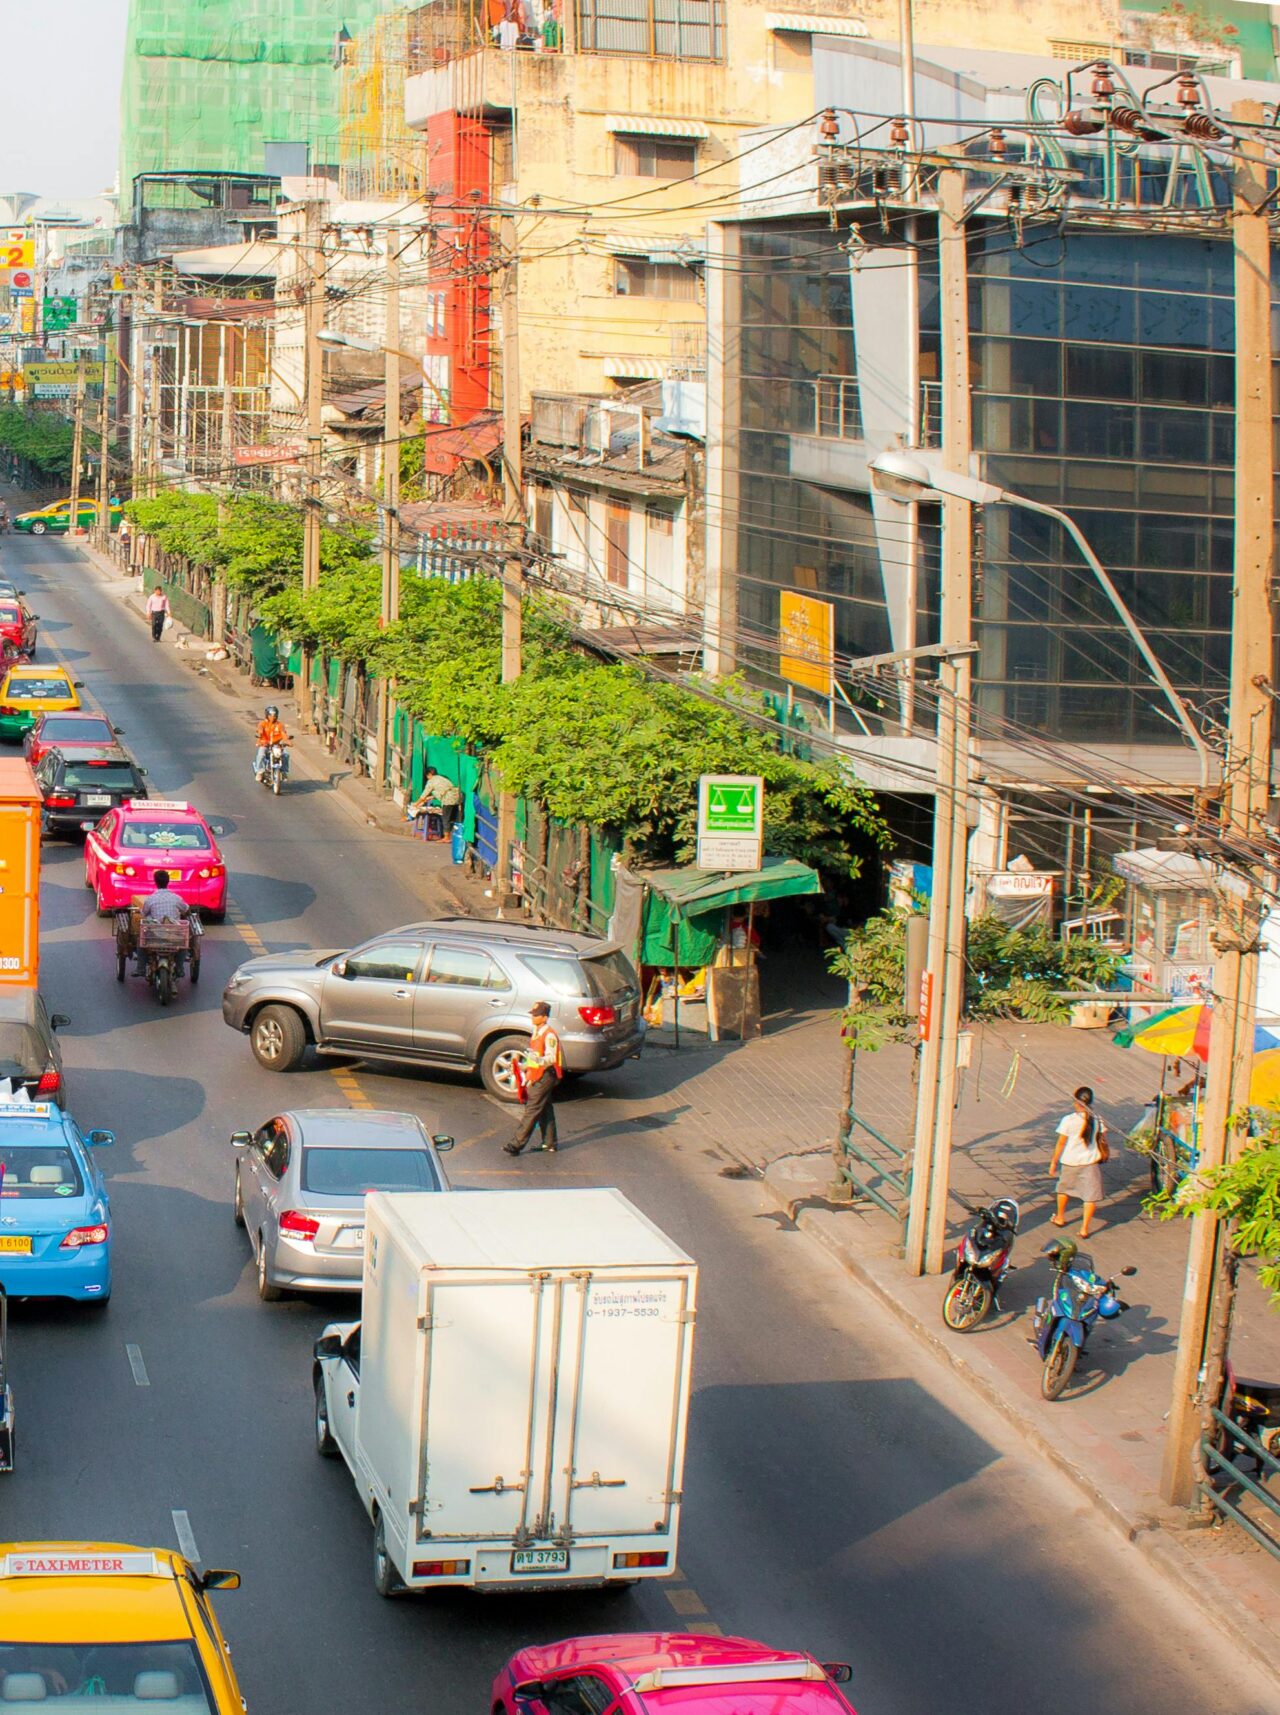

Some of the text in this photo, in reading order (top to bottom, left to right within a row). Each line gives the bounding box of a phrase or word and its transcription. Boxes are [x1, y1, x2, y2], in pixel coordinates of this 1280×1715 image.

[7, 247, 24, 267] 2
[6, 1238, 30, 1247] 6100
[586, 1308, 660, 1317] 0-1937-5530
[536, 1551, 566, 1563] 3793
[26, 1558, 124, 1572] TAXI-METER
